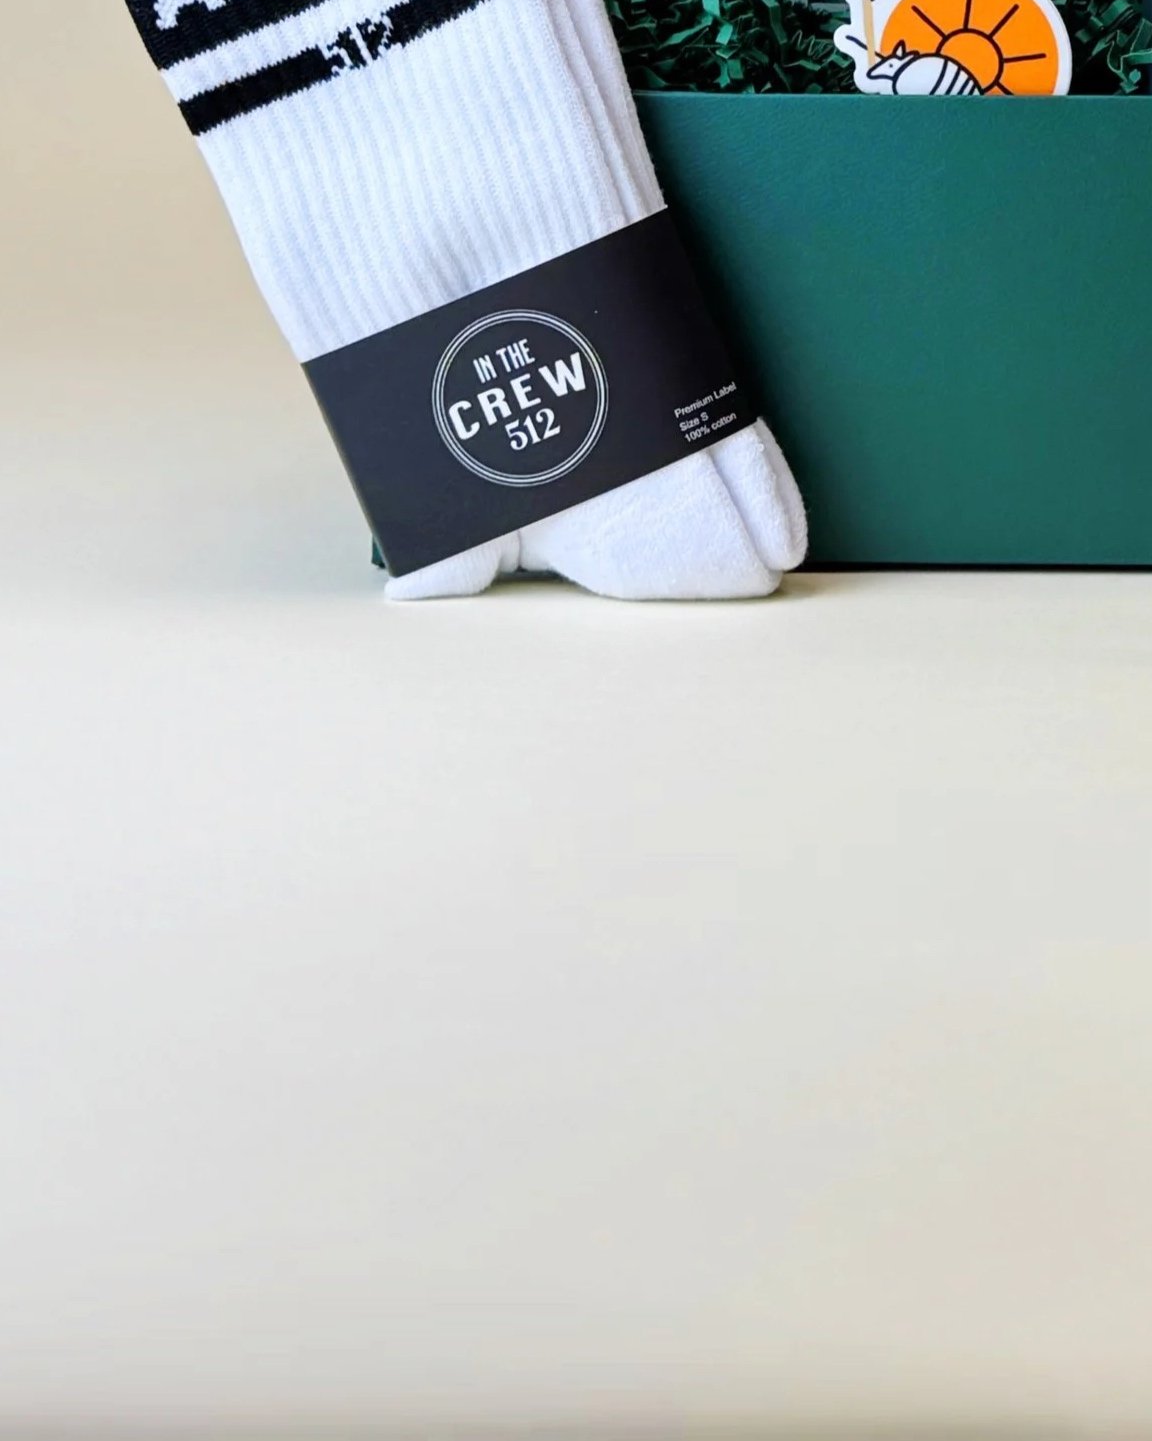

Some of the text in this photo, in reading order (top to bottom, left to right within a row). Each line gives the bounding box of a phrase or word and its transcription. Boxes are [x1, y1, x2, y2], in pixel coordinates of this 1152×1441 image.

[318, 12, 395, 73] 512
[473, 339, 536, 384] IN THE
[448, 352, 587, 441] CREW
[674, 380, 737, 419] Premium Label
[505, 408, 561, 451] 512
[679, 411, 709, 431] Size S
[684, 412, 737, 442] 100% cotton
